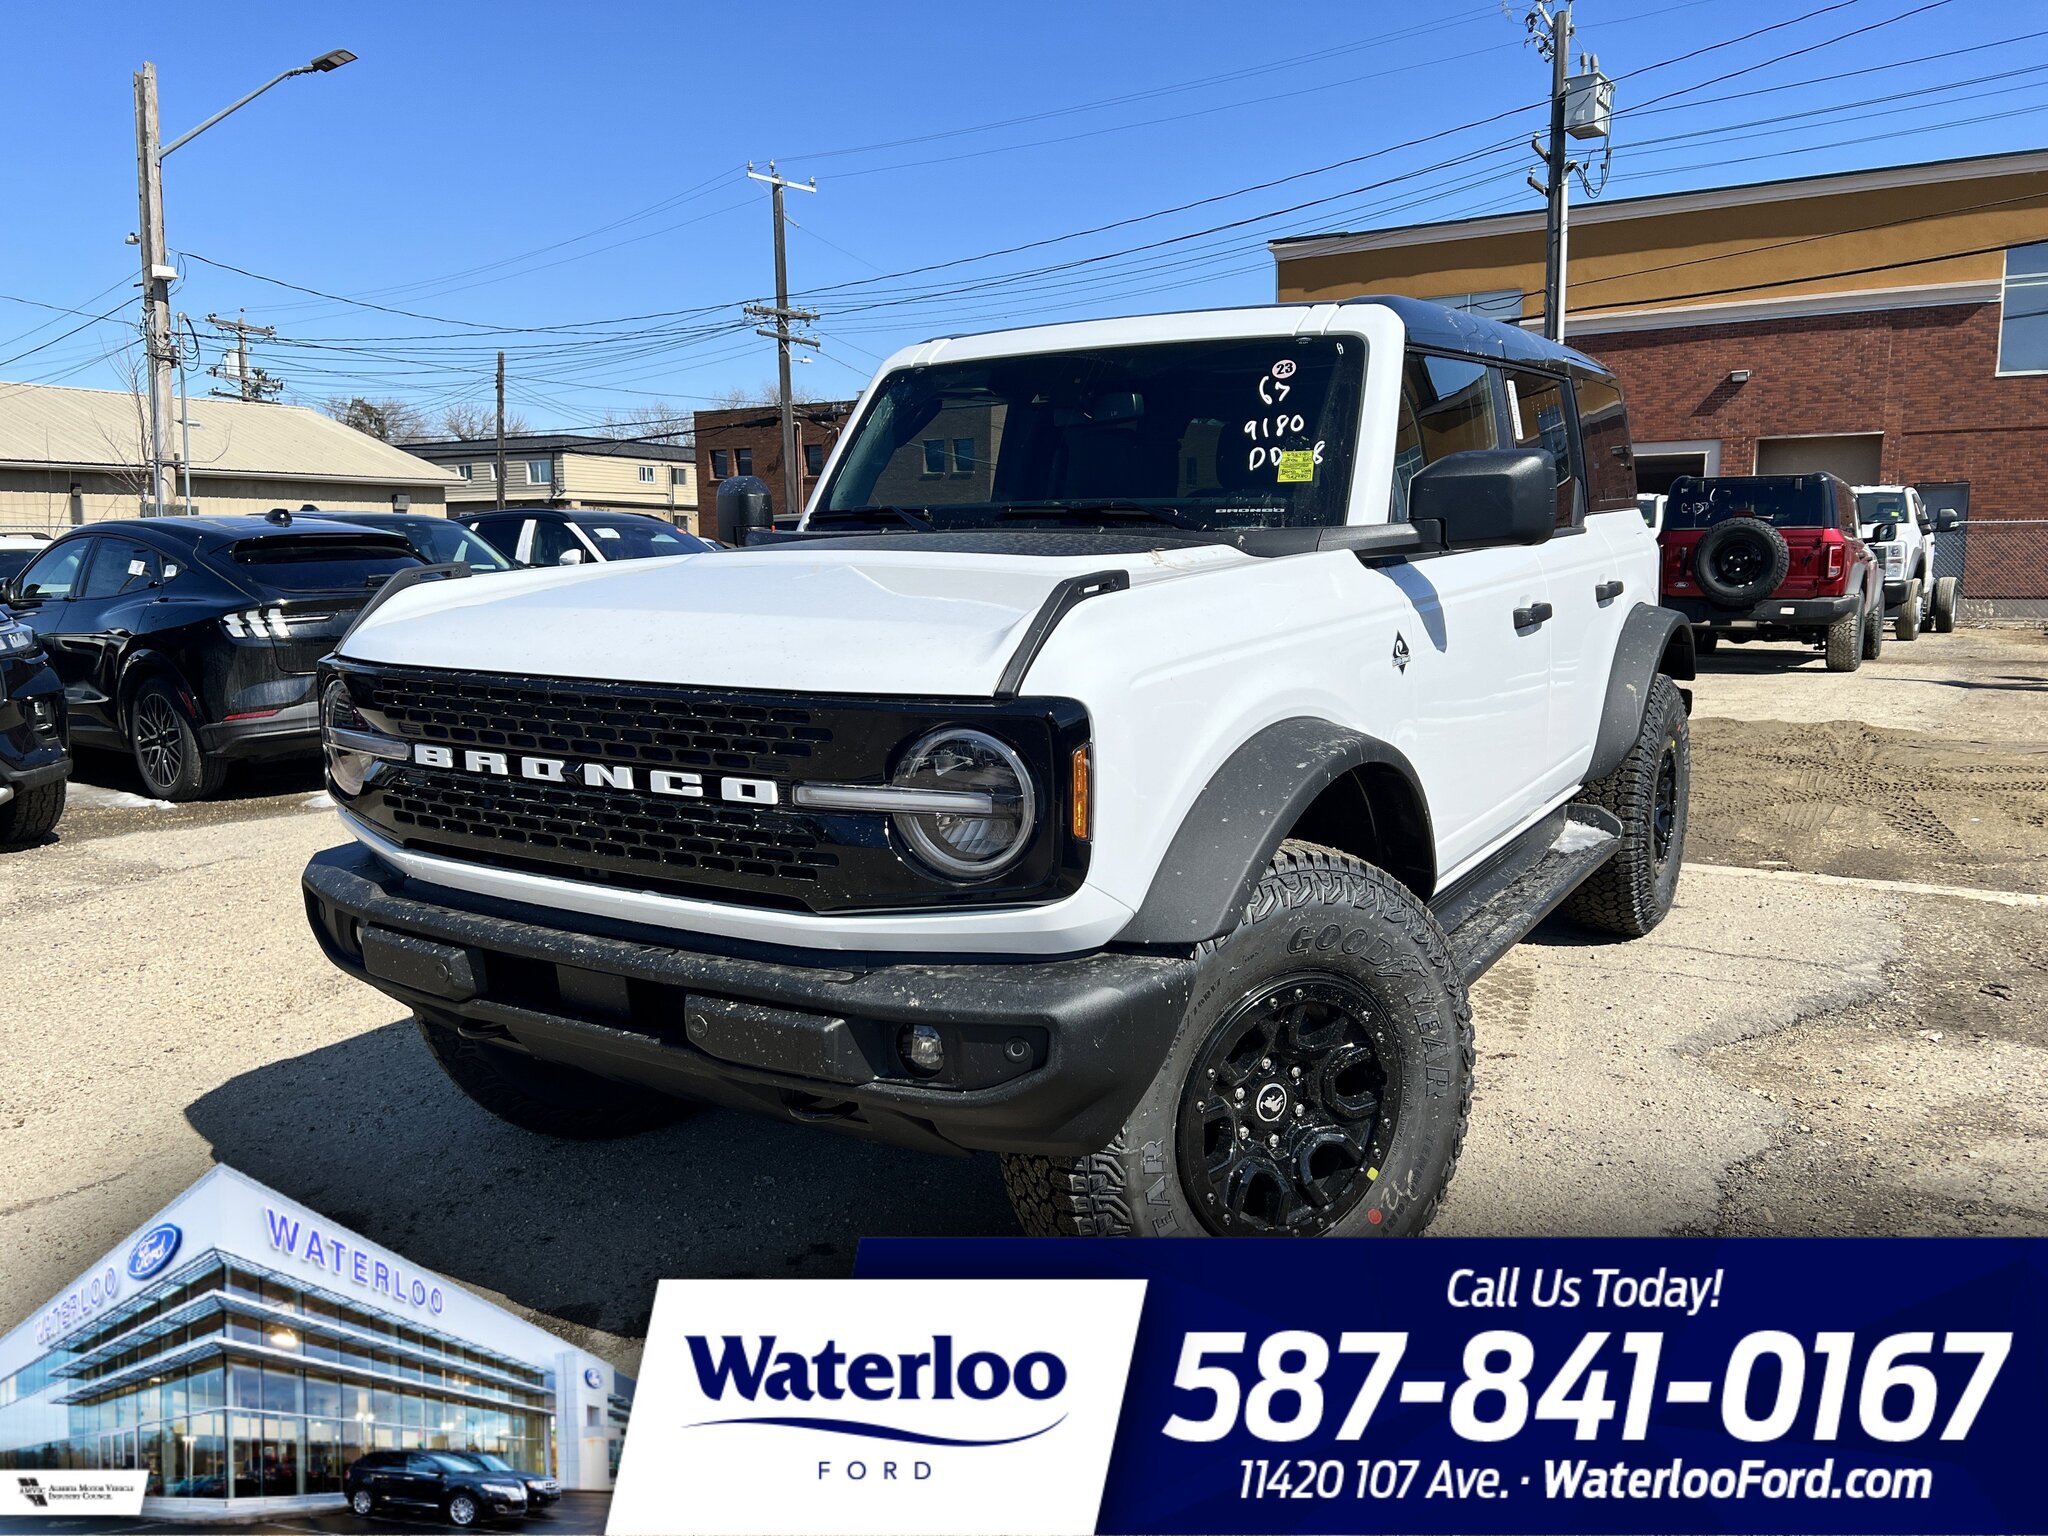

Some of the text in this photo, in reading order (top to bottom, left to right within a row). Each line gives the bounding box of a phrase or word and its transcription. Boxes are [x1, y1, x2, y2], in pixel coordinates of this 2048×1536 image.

[1276, 362, 1294, 376] 23
[1243, 414, 1305, 440] 9180
[414, 742, 780, 805] BRONCO
